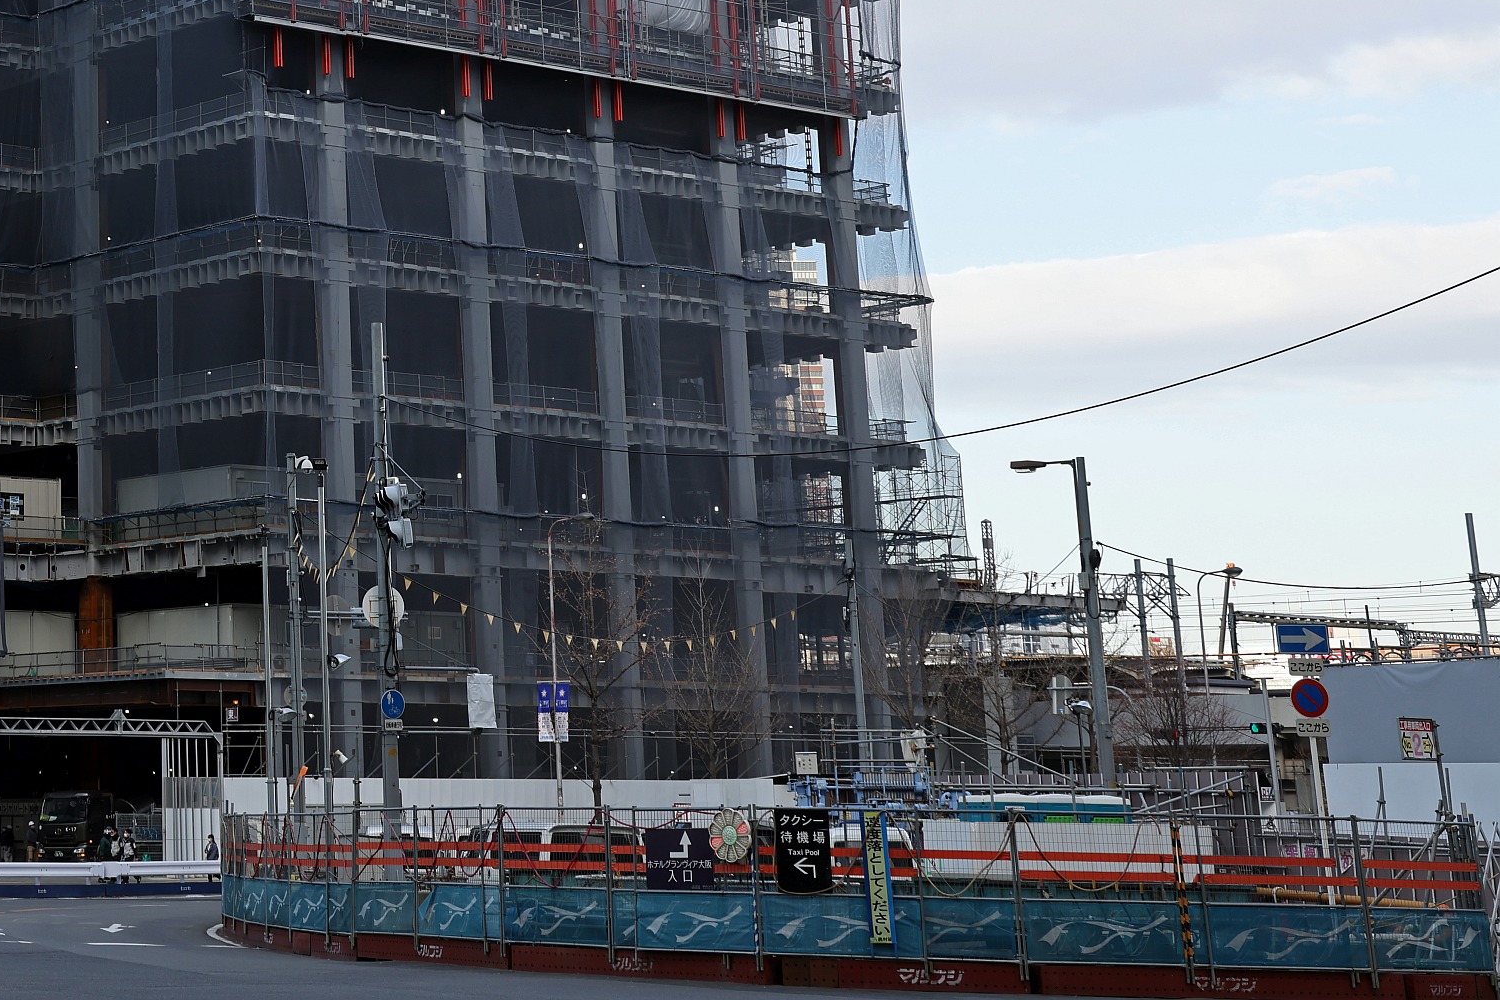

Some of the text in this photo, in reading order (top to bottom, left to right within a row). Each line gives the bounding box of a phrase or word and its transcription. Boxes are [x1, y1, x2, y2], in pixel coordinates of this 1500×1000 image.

[1290, 662, 1323, 673] ここから
[1298, 722, 1330, 733] ここから
[1412, 733, 1424, 757] 2
[779, 814, 824, 826] タクシー
[780, 831, 826, 844] 待機場
[787, 848, 820, 856] Taxi Pool
[647, 859, 712, 870] ホテルグランヴィア大阪
[667, 869, 693, 883] 入口
[864, 816, 891, 936] 速度落としてください
[1429, 984, 1463, 997] マルフジ
